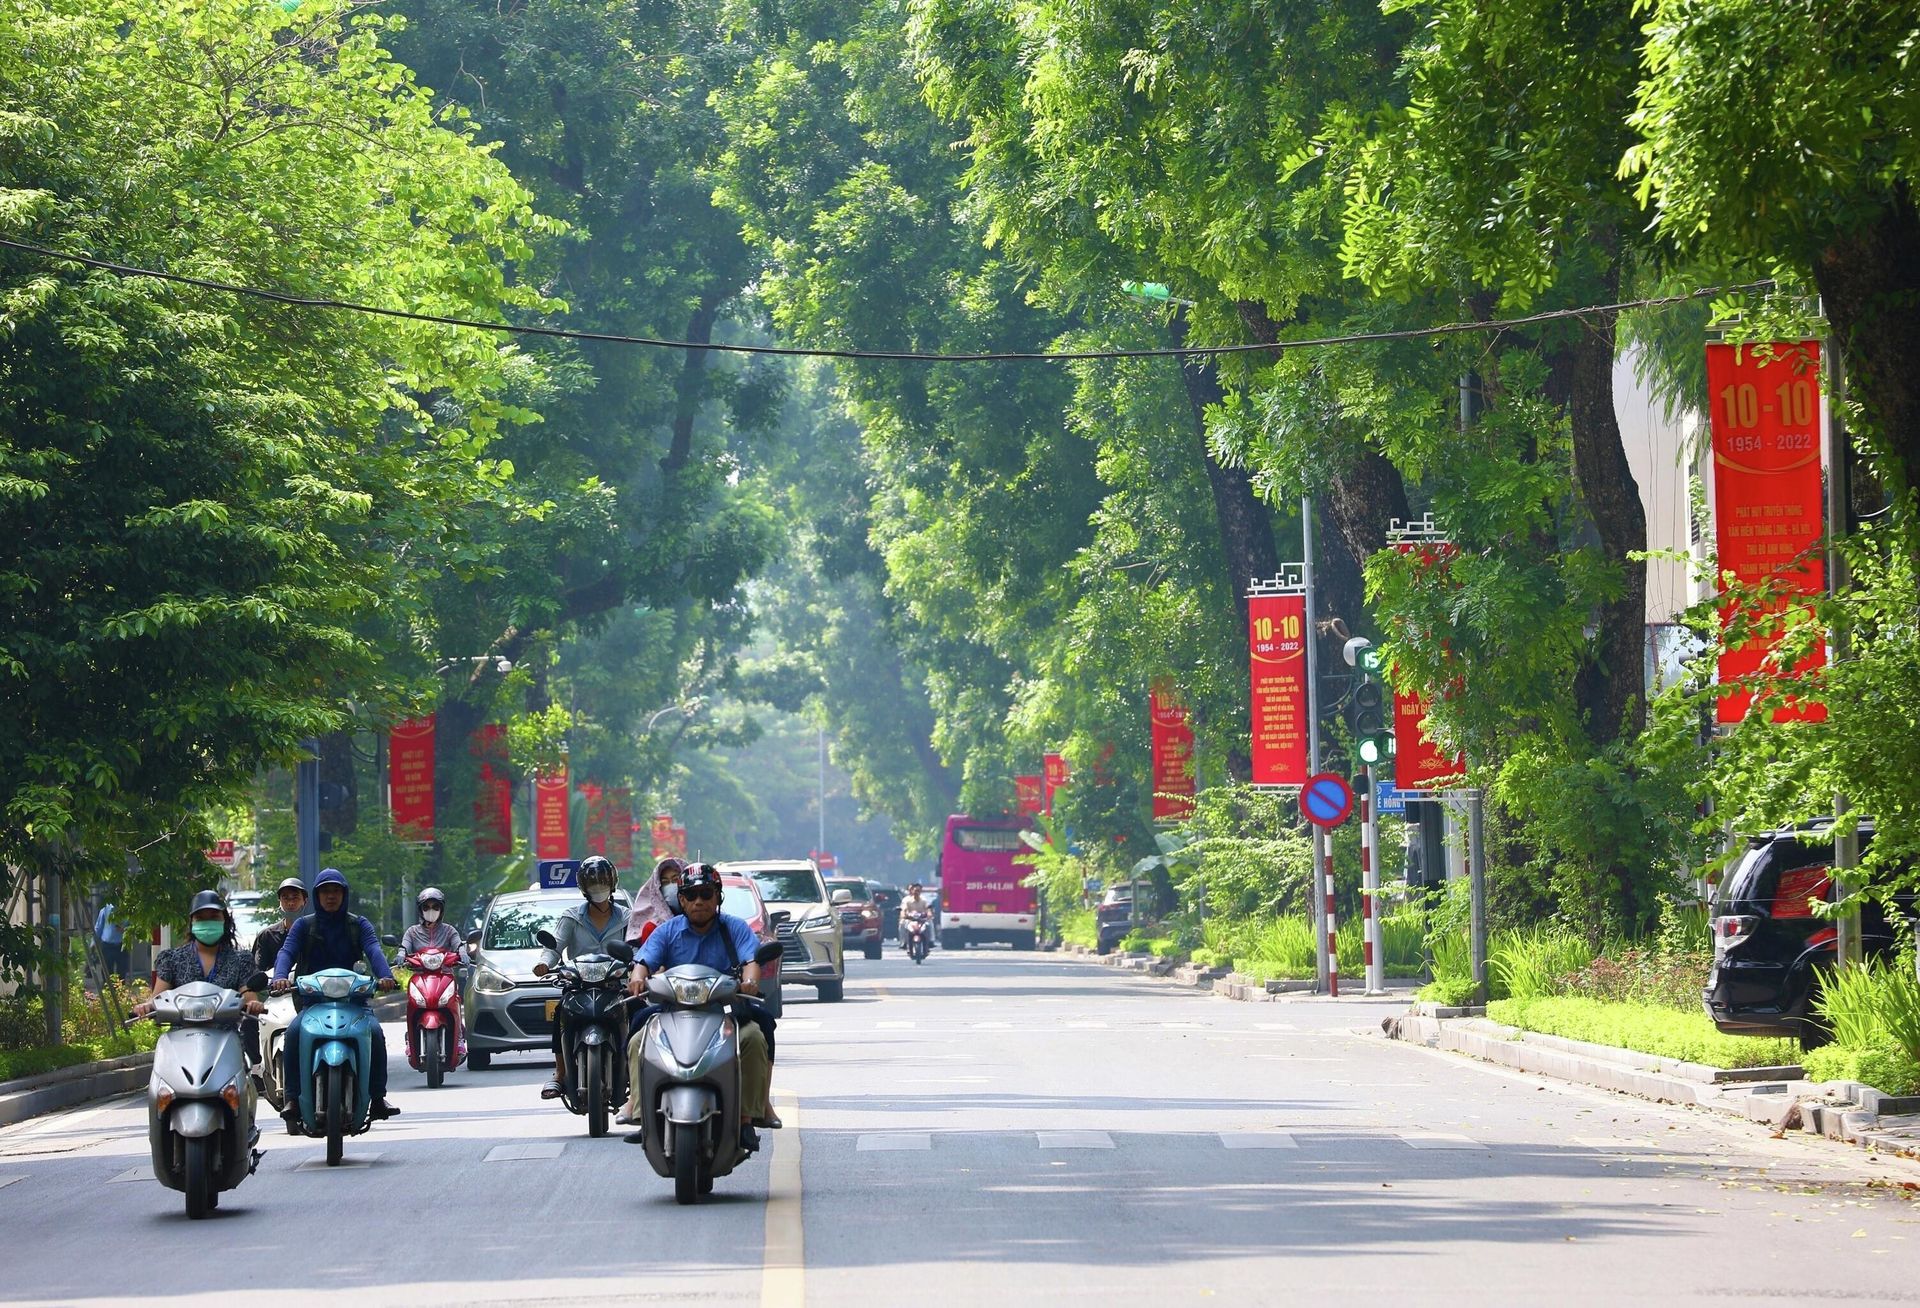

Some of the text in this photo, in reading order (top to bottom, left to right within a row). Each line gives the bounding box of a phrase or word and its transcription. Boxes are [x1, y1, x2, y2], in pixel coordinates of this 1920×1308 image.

[1727, 436, 1762, 452] 1954
[1777, 433, 1812, 450] 2022
[1256, 643, 1274, 652] 1954
[1280, 641, 1299, 651] 2022
[1364, 652, 1379, 668] 15
[550, 863, 571, 885] G7
